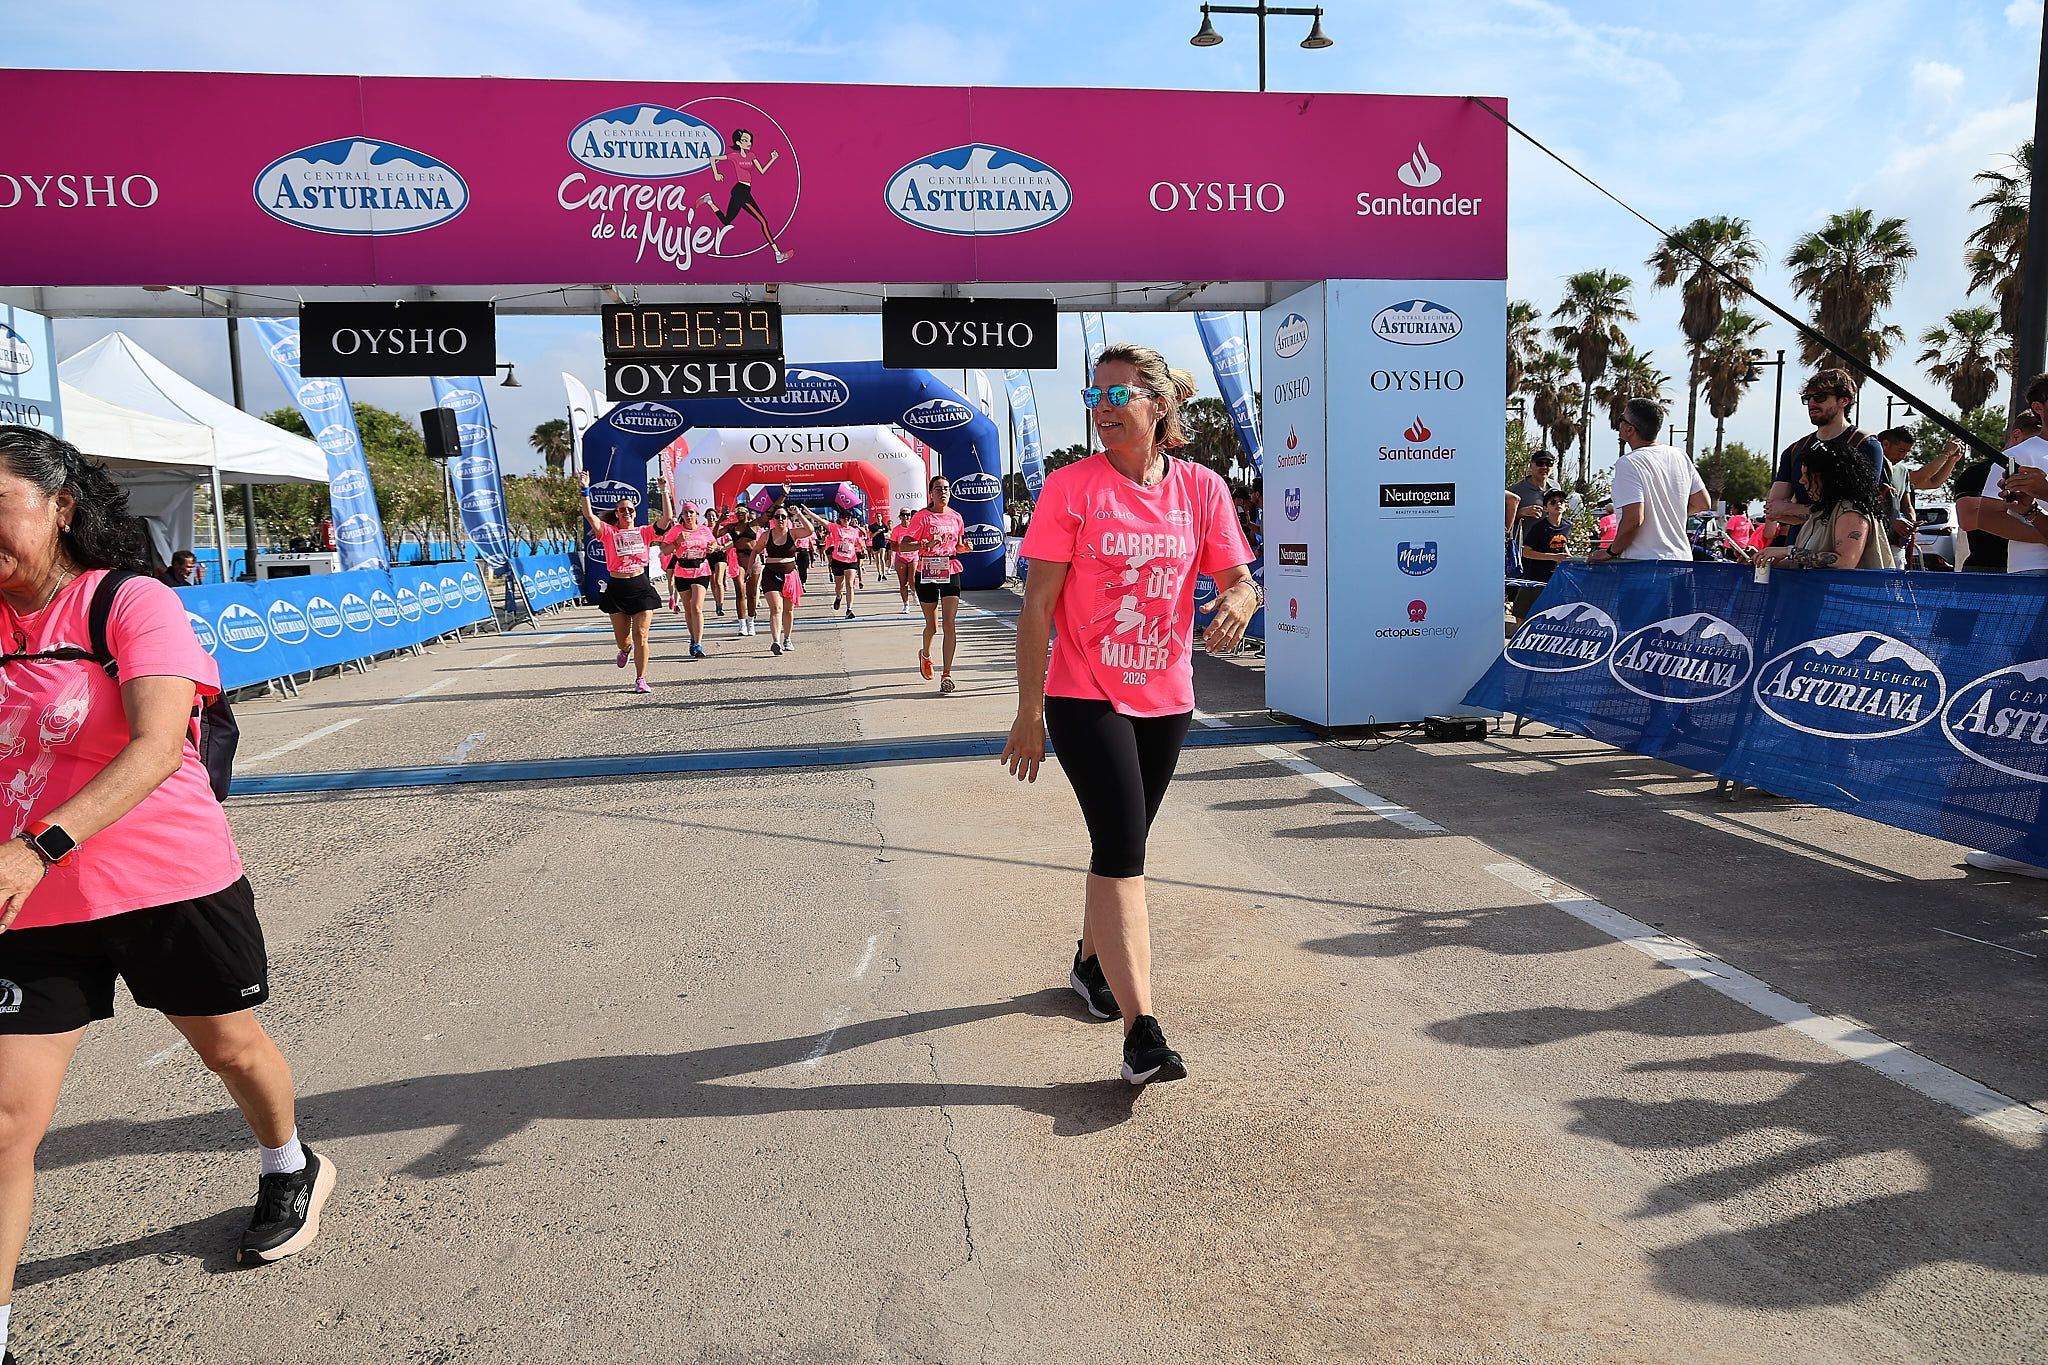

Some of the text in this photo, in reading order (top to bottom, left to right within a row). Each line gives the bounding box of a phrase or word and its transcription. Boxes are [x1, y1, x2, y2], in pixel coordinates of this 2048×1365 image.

[603, 128, 707, 138] CENTRAL LECHERA
[580, 130, 712, 160] ASTURIANA
[303, 171, 444, 182] CENTRAL LECHERA
[928, 175, 1052, 186] CENTRAL LECHERA
[0, 174, 159, 208] OYSHO
[272, 173, 454, 210] ASTURIANA
[557, 172, 686, 212] Carrera
[900, 177, 1058, 212] ASTURIANA
[1148, 180, 1286, 213] OYSHO
[1356, 192, 1482, 218] Santander
[591, 207, 735, 271] de la Mujer
[614, 311, 770, 349] 00:36:39
[911, 319, 1033, 348] OYSHO
[1377, 316, 1456, 334] ASTURIANA
[331, 327, 467, 355] OYSHO
[1276, 329, 1307, 352] ASTURIANA
[614, 361, 777, 396] OYSHO
[1370, 369, 1464, 391] OYSHO
[1274, 376, 1310, 405] OYSHO
[614, 412, 678, 427] ASTURIANA
[910, 411, 969, 424] ASTURIANA
[750, 432, 850, 453] OYSHO
[1378, 445, 1456, 461] Santander
[690, 456, 720, 465] OYSHO
[877, 451, 908, 460] OYSHO
[1277, 452, 1308, 468] Santander
[757, 460, 843, 474] Sports Santander
[894, 491, 923, 500] OYSHO
[1385, 488, 1450, 505] Neutrogena
[1096, 510, 1135, 520] OYSHO
[1399, 549, 1436, 568] Marlene
[223, 623, 266, 643] ASTURIANA
[1375, 625, 1460, 640] octopus energy
[1508, 624, 1603, 661] ASTURIANA
[1568, 626, 1607, 638] LECHERA
[1101, 642, 1169, 670] MUJER
[1650, 638, 1742, 660] CENTRAL LECHERA
[1614, 637, 1737, 688] ASTURIANA
[1122, 671, 1147, 685] 2026
[1803, 661, 1928, 688] CENTRAL LECHERA
[1760, 660, 1924, 722] ASTURIANA
